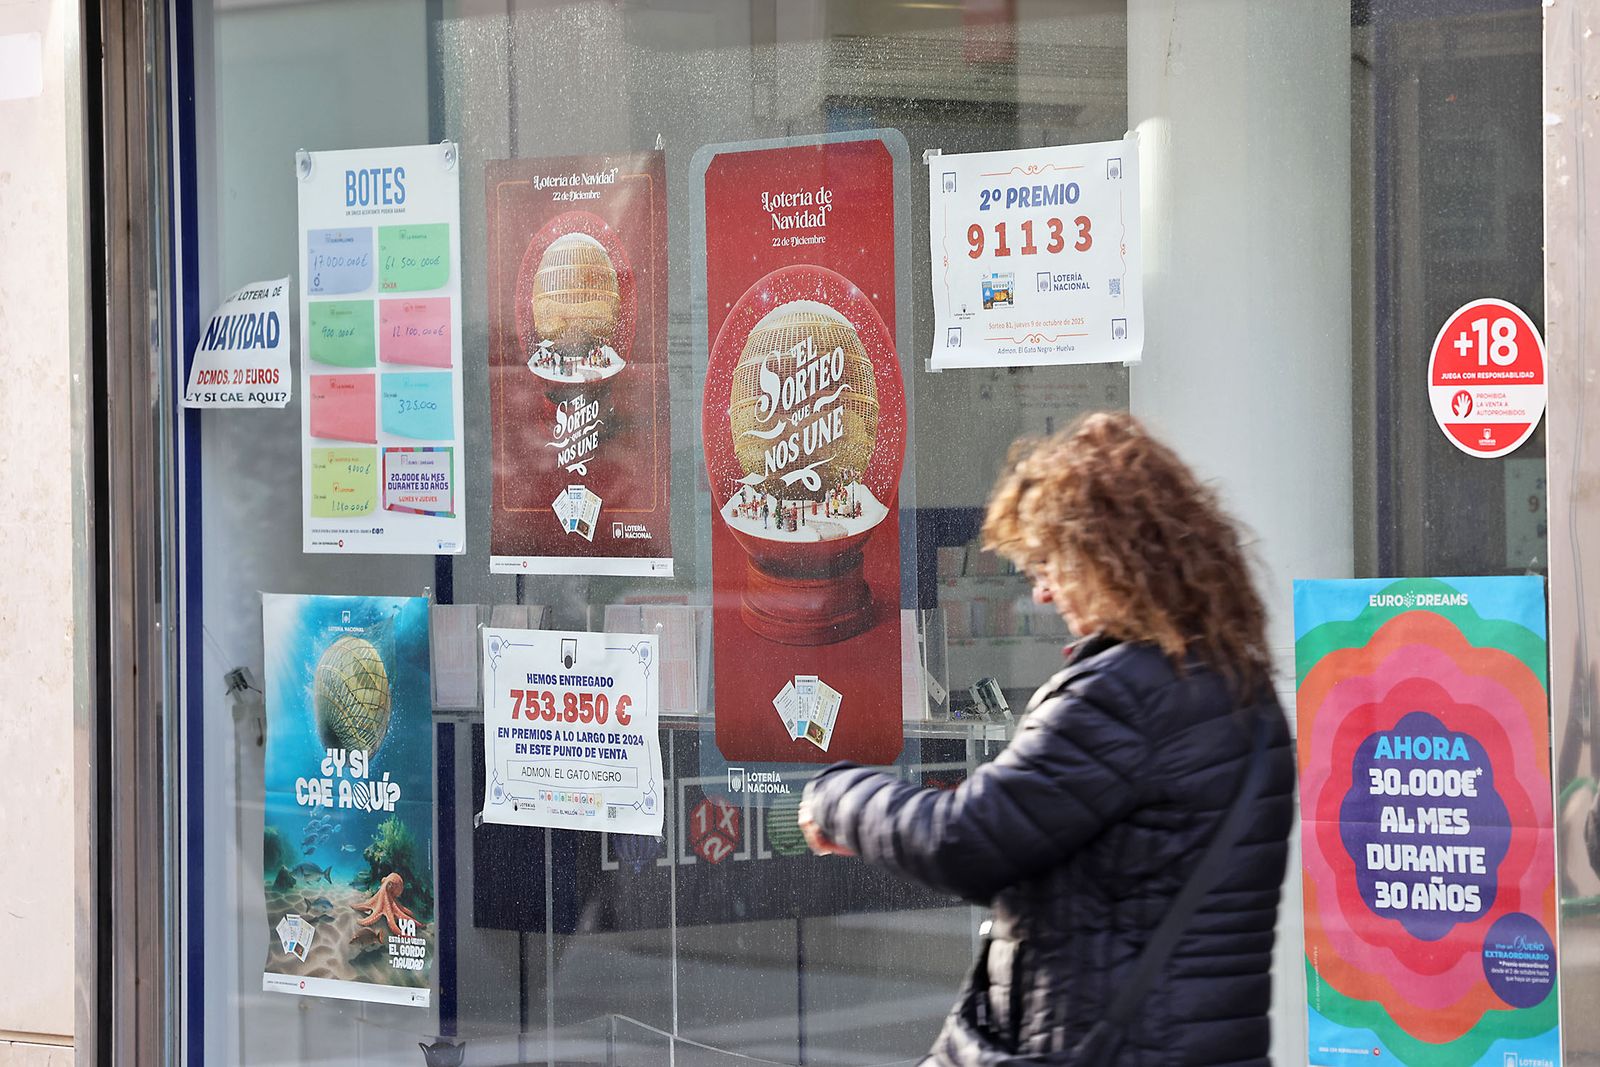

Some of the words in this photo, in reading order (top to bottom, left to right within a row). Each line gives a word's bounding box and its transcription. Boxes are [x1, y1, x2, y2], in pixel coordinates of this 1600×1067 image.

[346, 167, 405, 207] BOTES
[533, 174, 568, 190] Lotería
[569, 173, 580, 186] de
[581, 167, 618, 185] Navidad
[552, 192, 560, 201] 22
[561, 191, 568, 200] de
[569, 190, 600, 201] Diciembre
[761, 188, 813, 212] Lotería
[815, 186, 832, 204] de
[979, 188, 1001, 211] 2º
[1006, 182, 1080, 209] PREMIO
[771, 204, 833, 230] Navidad
[772, 237, 781, 246] 22
[781, 237, 790, 246] de
[790, 234, 826, 247] Diciembre
[967, 215, 1093, 259] 91133
[1053, 273, 1083, 282] LOTERÍA
[1053, 281, 1090, 292] NACIONAL
[272, 286, 282, 297] DE
[201, 311, 280, 351] NAVIDAD
[989, 322, 1005, 330] Sorteo
[1042, 319, 1063, 327] octubre
[1037, 345, 1052, 354] Negro
[1056, 344, 1075, 352] Huelva
[1454, 317, 1519, 366] +18
[789, 336, 817, 369] EL
[233, 369, 243, 384] 20
[245, 368, 279, 384] EUROS
[1477, 371, 1535, 379] RESPONSABILIDAD
[755, 346, 844, 423] SORTEO
[204, 392, 216, 402] SI
[220, 392, 244, 402] CAE
[248, 392, 287, 403] AQUI?
[569, 394, 586, 412] EL
[553, 400, 599, 439] SORTEO
[787, 404, 810, 426] QUE
[557, 444, 576, 468] NOS
[577, 430, 599, 457] UNE
[764, 432, 800, 478] NOS
[803, 405, 843, 456] UNE
[388, 482, 419, 490] DURANTE
[420, 482, 429, 490] 30
[430, 480, 449, 490] AÑOS
[421, 473, 430, 481] AL
[431, 473, 445, 481] MES
[624, 524, 646, 532] LOTERÍA
[1369, 594, 1403, 607] EURO
[1416, 593, 1468, 606] DREAMS
[527, 673, 557, 686] HEMOS
[559, 675, 614, 688] ENTREGADO
[510, 689, 609, 725] 753.850
[615, 694, 633, 727] €
[498, 727, 509, 738] EN
[511, 728, 552, 741] PREMIOS
[554, 730, 561, 741] A
[563, 731, 574, 743] LO
[577, 731, 605, 744] LARGO
[607, 733, 621, 744] DE
[622, 734, 644, 746] 2024
[515, 743, 527, 754] EN
[529, 744, 551, 756] ESTE
[553, 745, 582, 758] PUNTO
[585, 747, 596, 758] DE
[599, 748, 628, 760] VENTA
[1374, 736, 1470, 761] AHORA
[321, 748, 346, 778] ¿Y
[349, 749, 368, 779] SI
[521, 766, 552, 778] ADMON.
[555, 768, 564, 779] EL
[566, 769, 590, 780] GATO
[591, 770, 622, 782] NEGRO
[747, 771, 781, 782] LOTERÍA
[295, 777, 333, 807] CAE
[338, 772, 401, 813] AQUÍ?
[747, 783, 790, 794] NACIONAL
[1380, 806, 1415, 833] AL
[1416, 807, 1470, 835] MES
[1366, 843, 1486, 874] DURANTE
[1375, 881, 1408, 909] 30
[1411, 876, 1481, 913] AÑOS
[398, 918, 416, 936] YA
[388, 943, 399, 956] EL
[400, 945, 426, 958] GORDO
[1485, 950, 1549, 960] EXTRAORDINARIO
